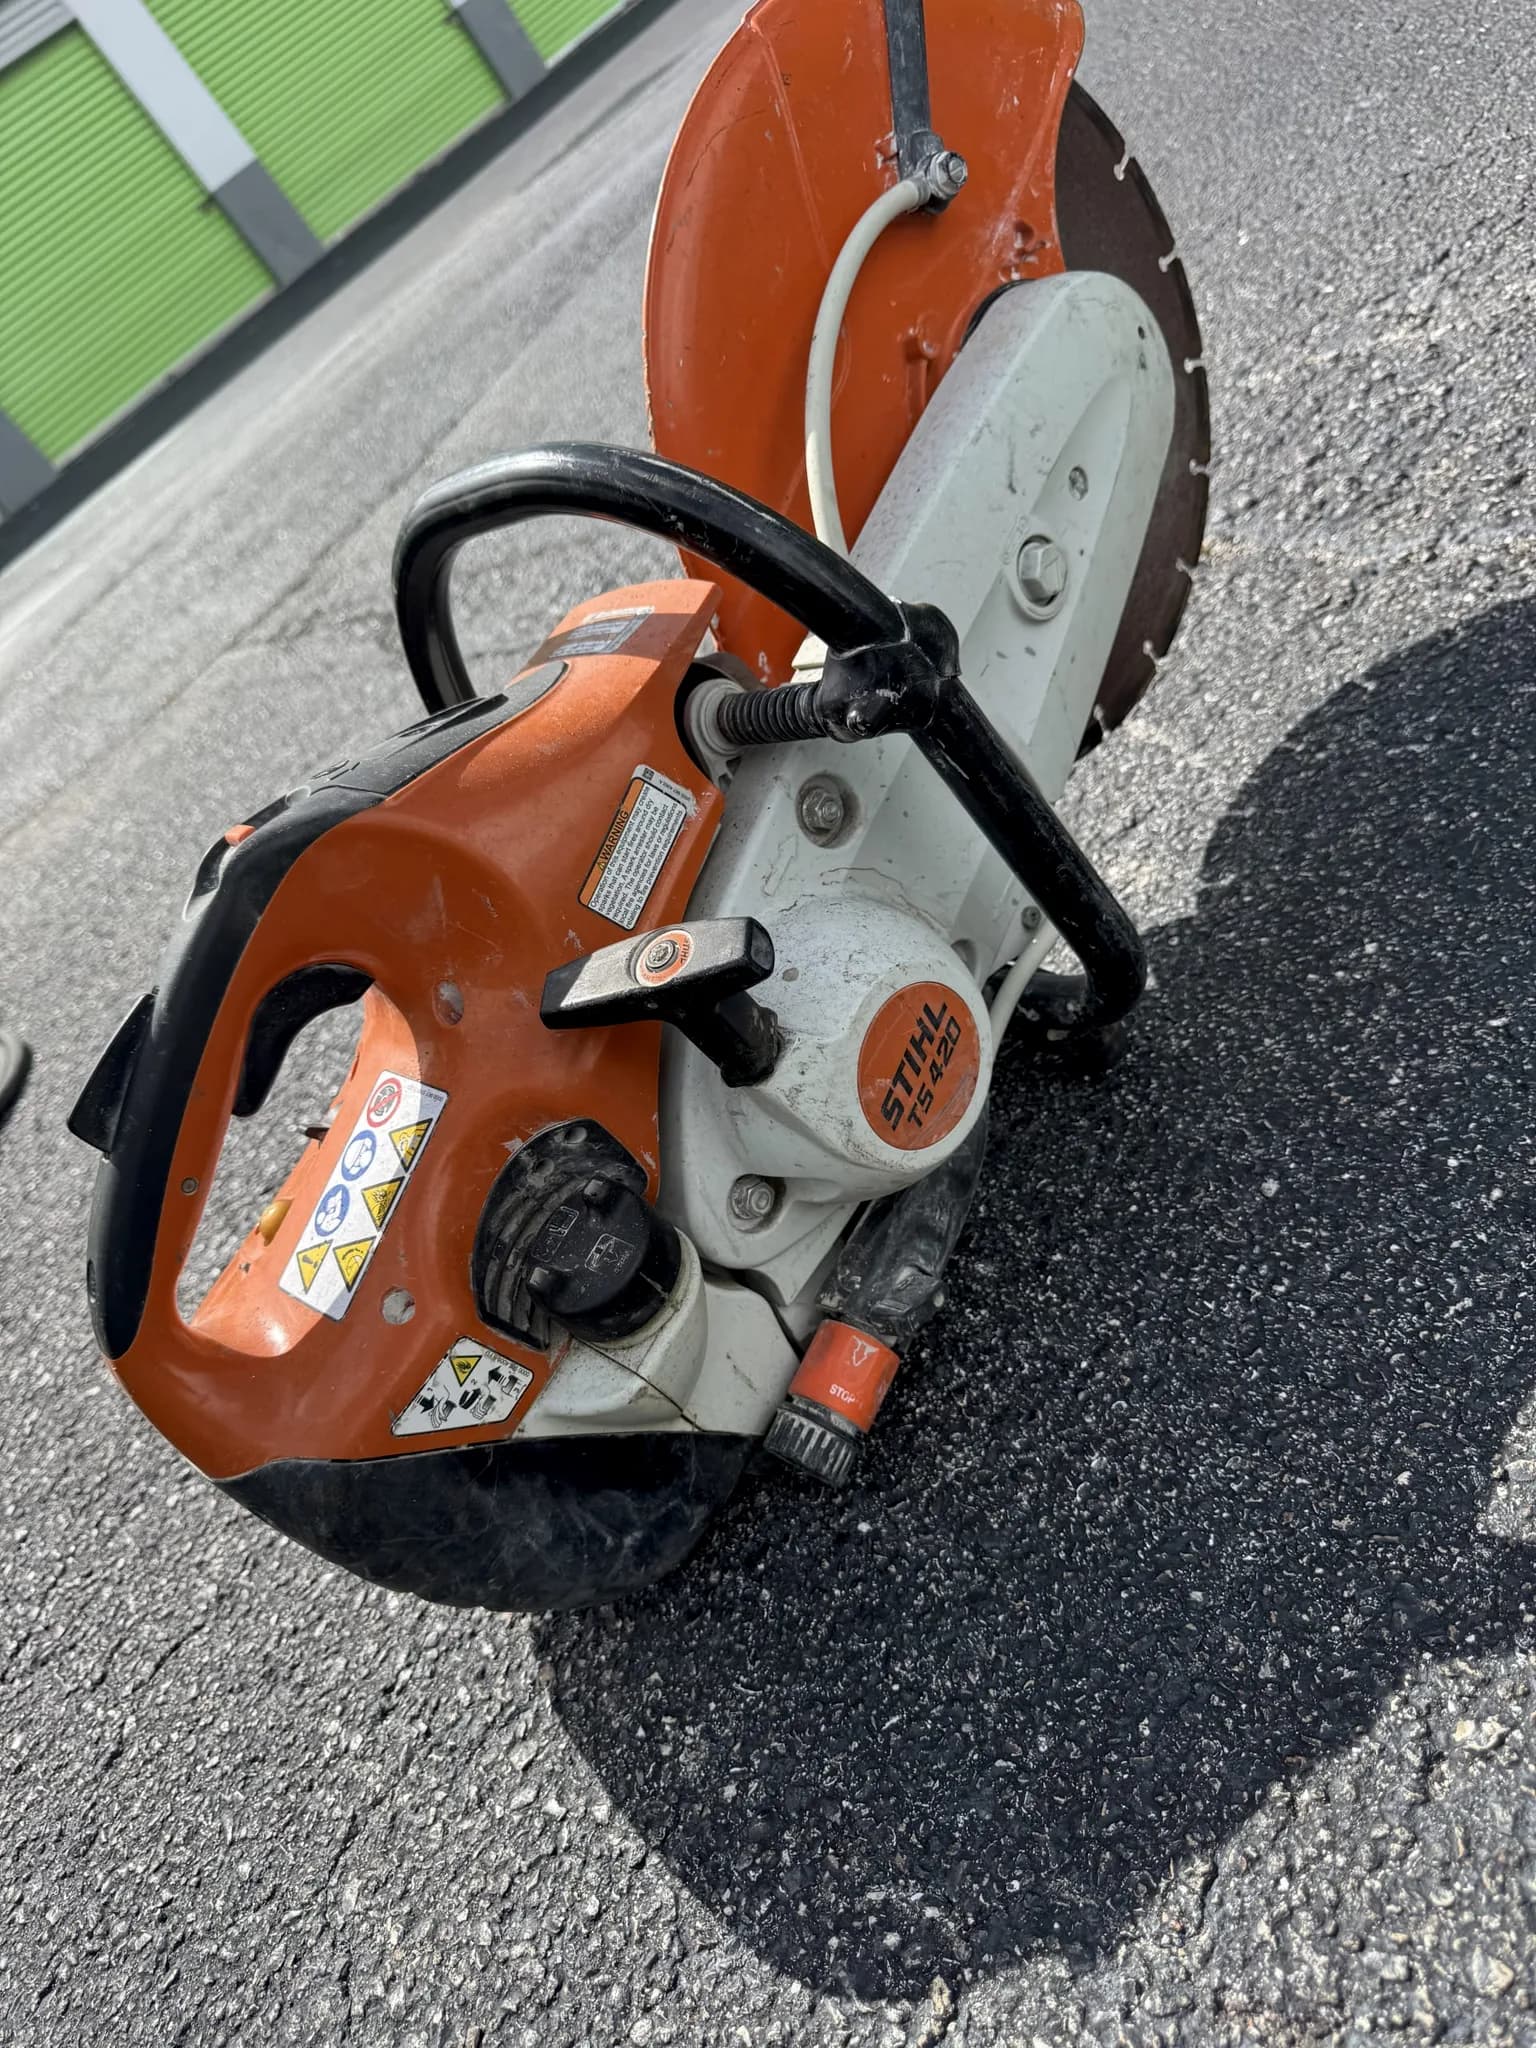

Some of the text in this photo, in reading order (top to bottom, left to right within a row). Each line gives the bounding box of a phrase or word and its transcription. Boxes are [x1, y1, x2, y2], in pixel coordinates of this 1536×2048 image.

[589, 875, 609, 908] Operation
[605, 866, 612, 875] of
[615, 820, 635, 855] equipment
[631, 806, 642, 821] may
[597, 798, 654, 912] sparks that can start fires around dry
[599, 809, 629, 861] WARNING
[618, 802, 678, 924] local fire agencies for laws or regulations
[624, 855, 637, 875] spark
[632, 830, 648, 855] arrester
[645, 815, 655, 831] may
[651, 805, 659, 815] be
[625, 876, 635, 890] The
[631, 849, 648, 877] operator
[643, 827, 657, 850] should
[653, 803, 668, 827] contact
[645, 850, 665, 885] prevention
[625, 903, 641, 928] relating
[636, 895, 643, 903] to
[638, 882, 648, 896] fire
[881, 1002, 948, 1131] STIHL
[906, 1015, 961, 1128] TS 420
[830, 1384, 856, 1404] STOP
